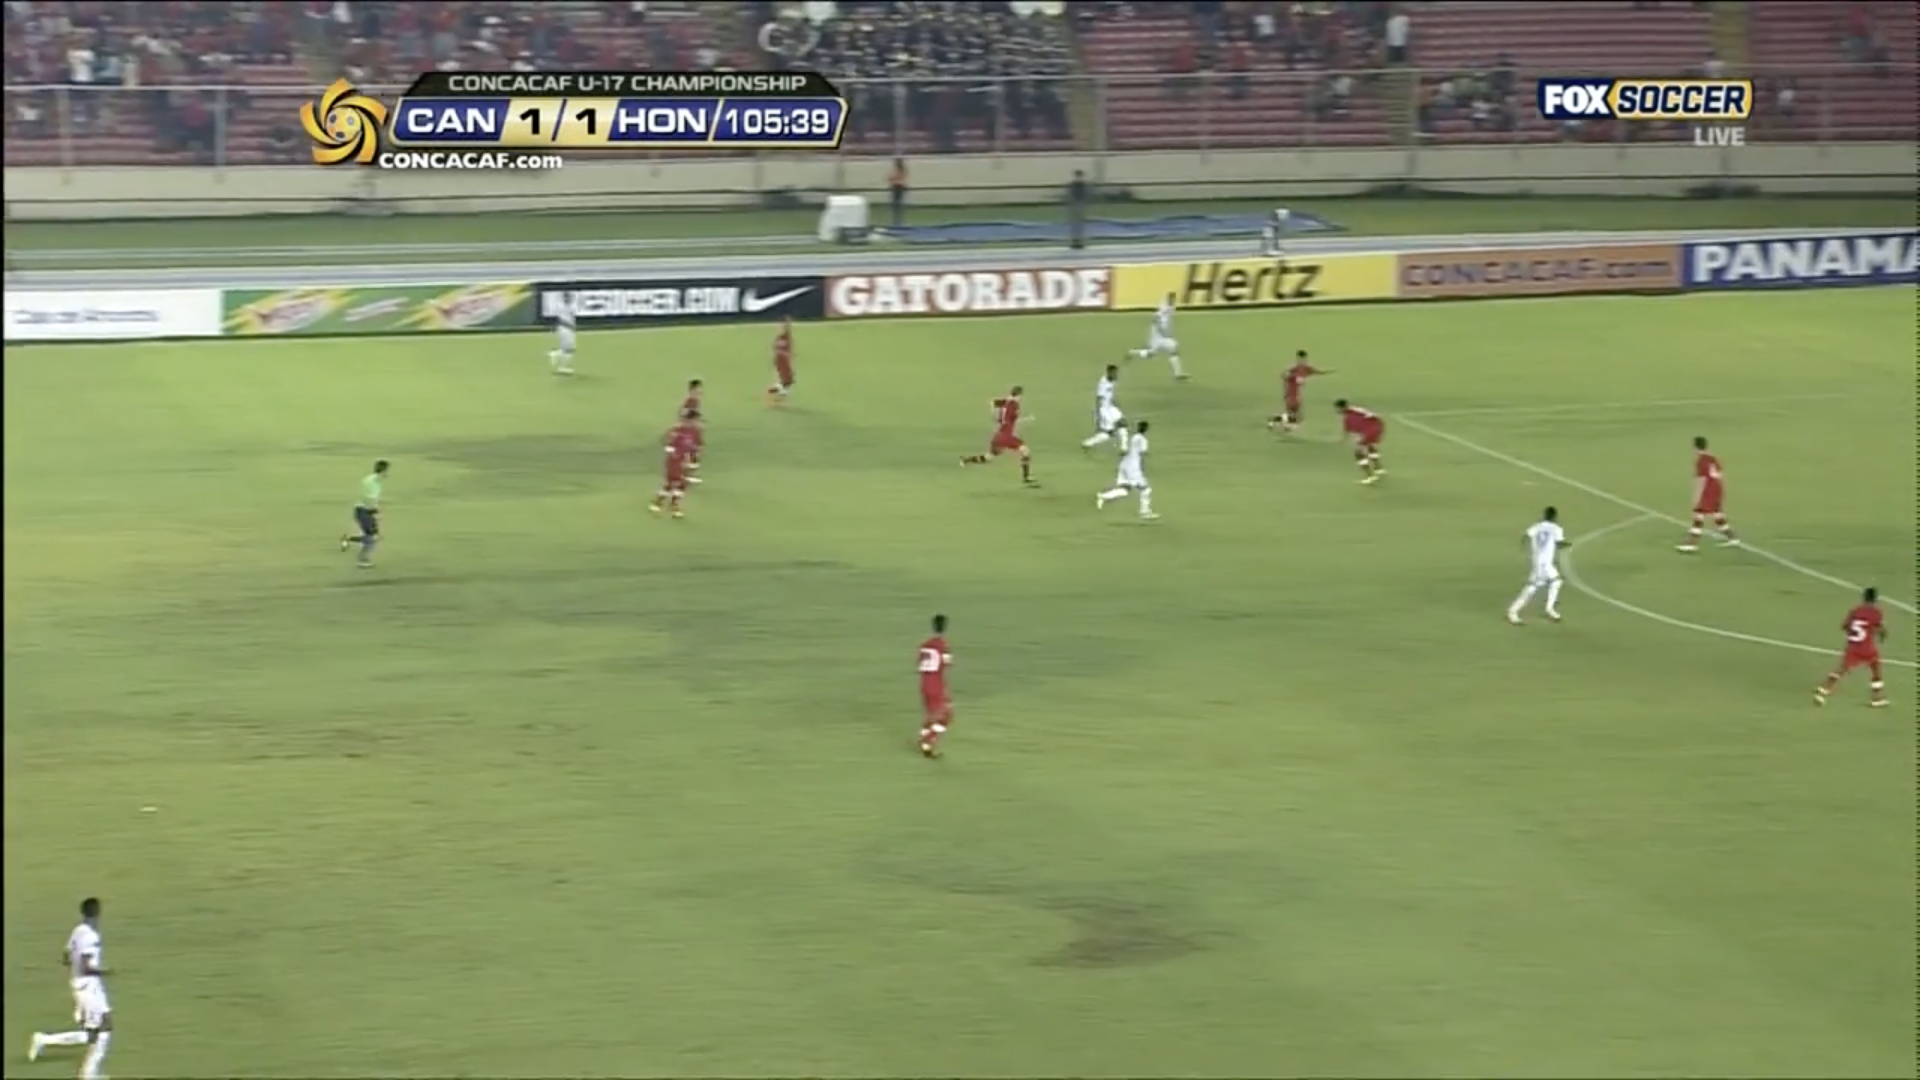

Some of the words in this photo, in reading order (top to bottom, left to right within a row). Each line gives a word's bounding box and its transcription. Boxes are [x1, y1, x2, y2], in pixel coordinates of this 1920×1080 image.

[1183, 259, 1323, 304] Hertz
[1405, 258, 1673, 286] CONCACAF.com
[830, 269, 1108, 315] GATORADE
[1848, 619, 1868, 642] 5
